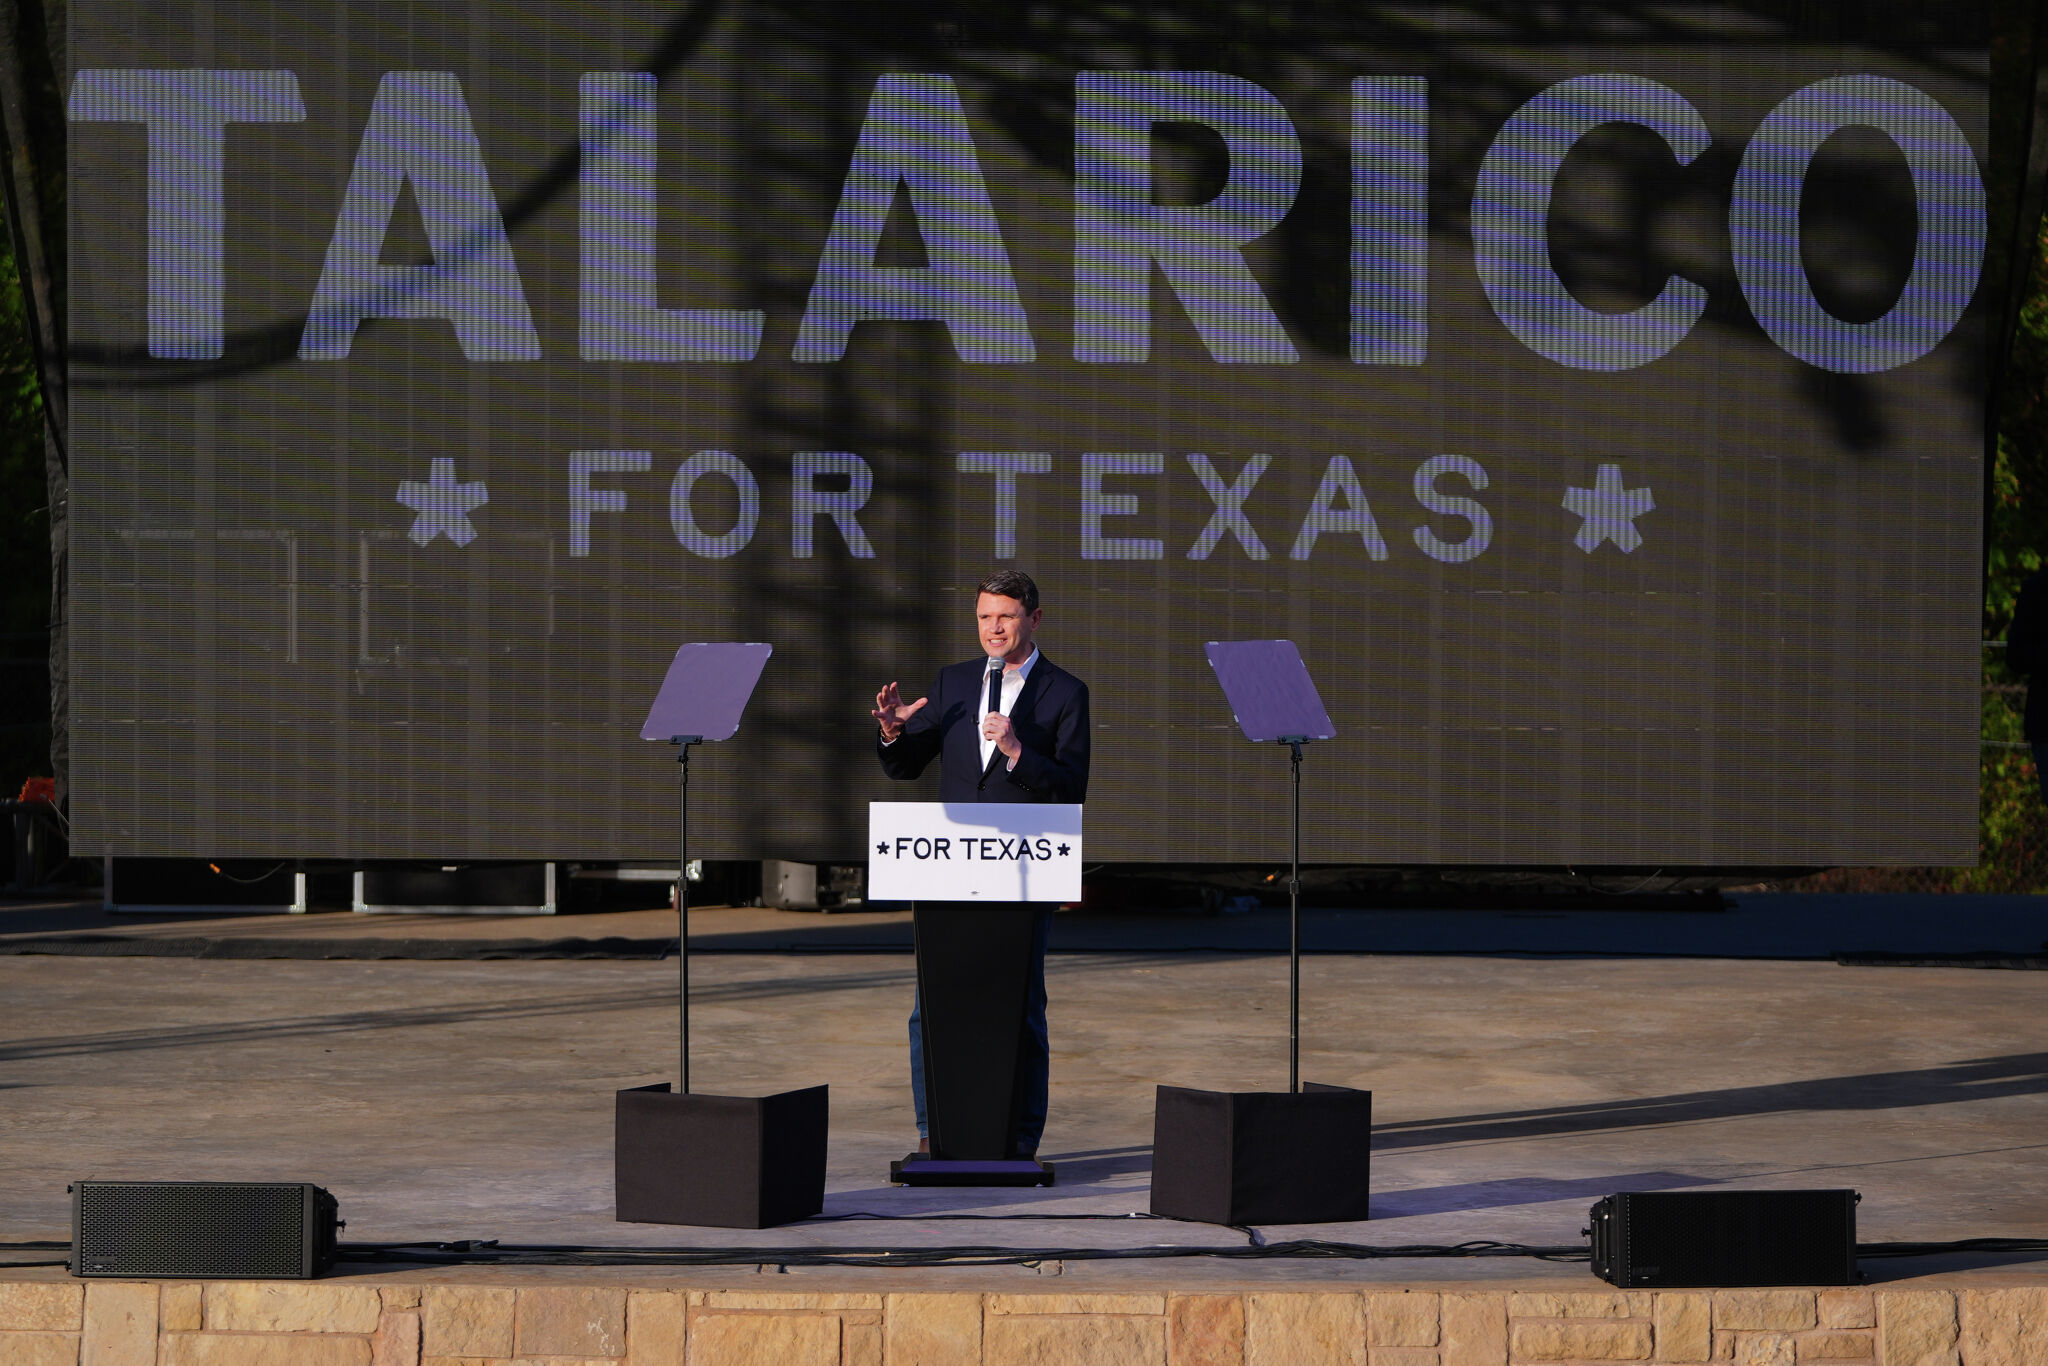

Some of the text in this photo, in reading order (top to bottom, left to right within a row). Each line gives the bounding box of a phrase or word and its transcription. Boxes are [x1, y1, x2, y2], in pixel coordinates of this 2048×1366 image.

[68, 69, 1986, 374] TALARICO
[568, 450, 1493, 563] FOR TEXAS
[896, 837, 1052, 861] FOR TEXAS
